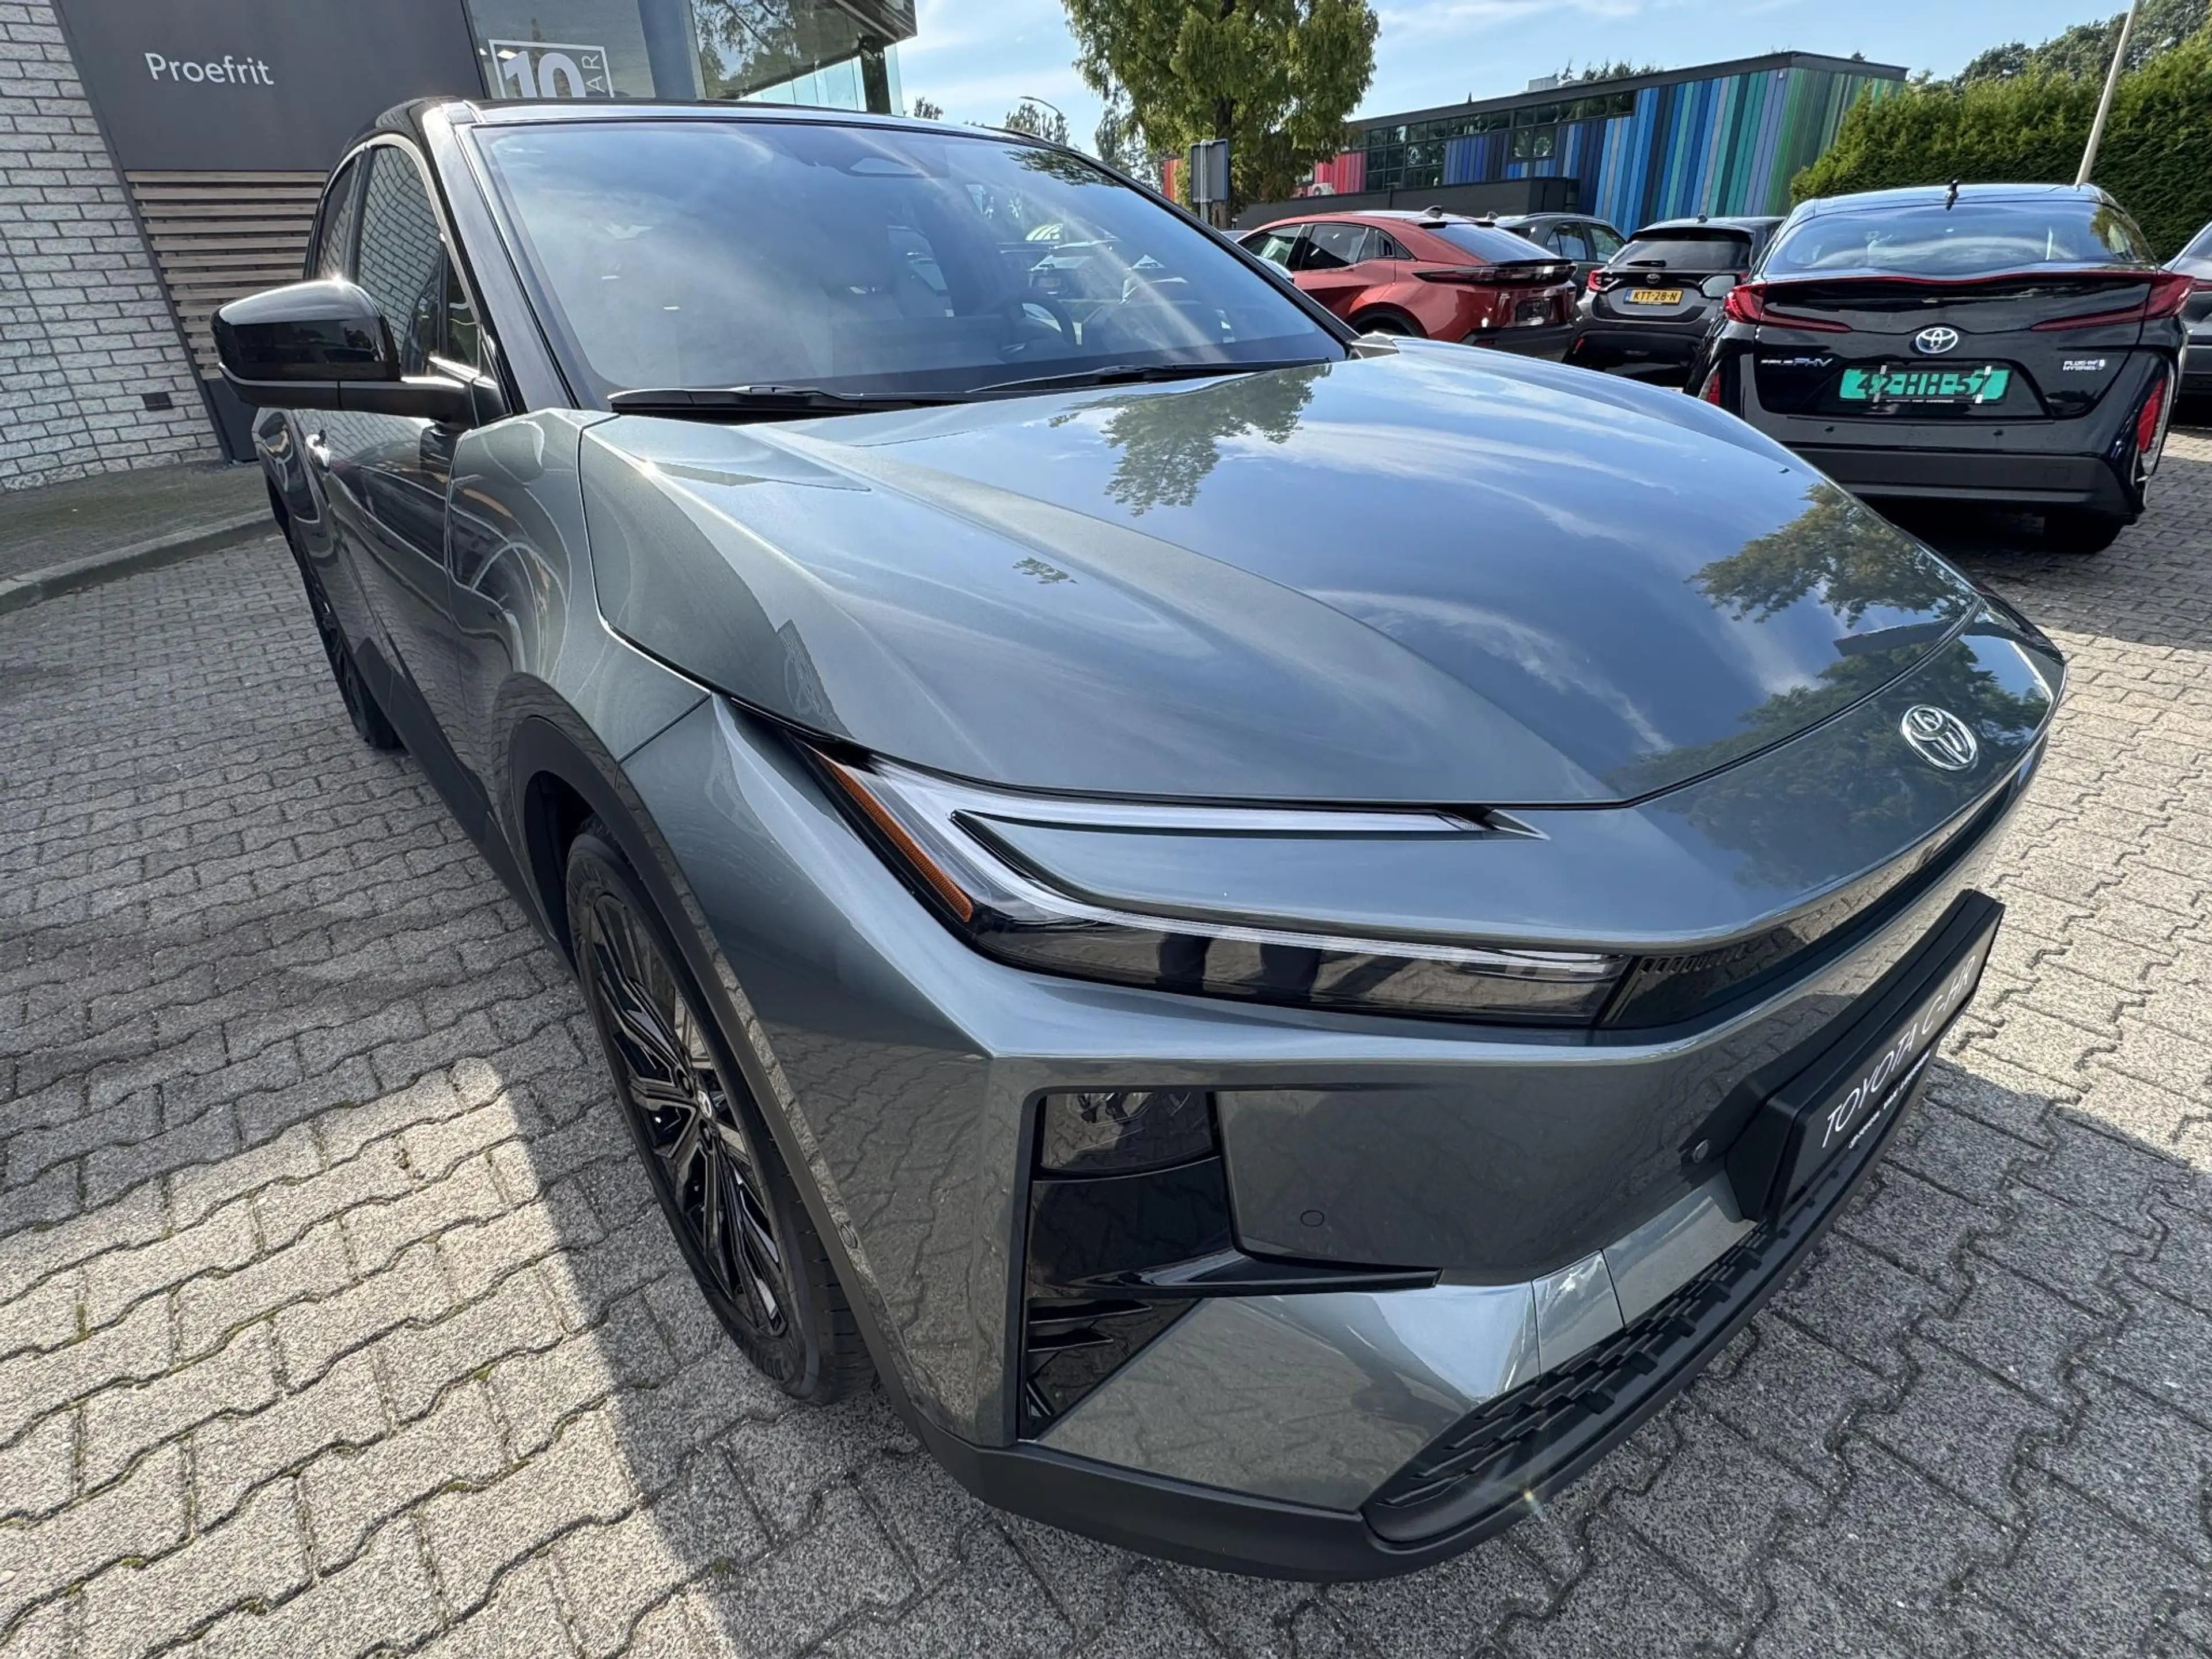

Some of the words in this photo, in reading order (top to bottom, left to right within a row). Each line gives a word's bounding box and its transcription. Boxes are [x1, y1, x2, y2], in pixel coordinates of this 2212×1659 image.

[144, 52, 274, 85] Proefrit
[502, 51, 586, 97] 10
[1634, 291, 1677, 301] KTT-28-N
[1822, 1022, 1918, 1148] TOYOTA
[1921, 955, 1976, 1035] C-HR
